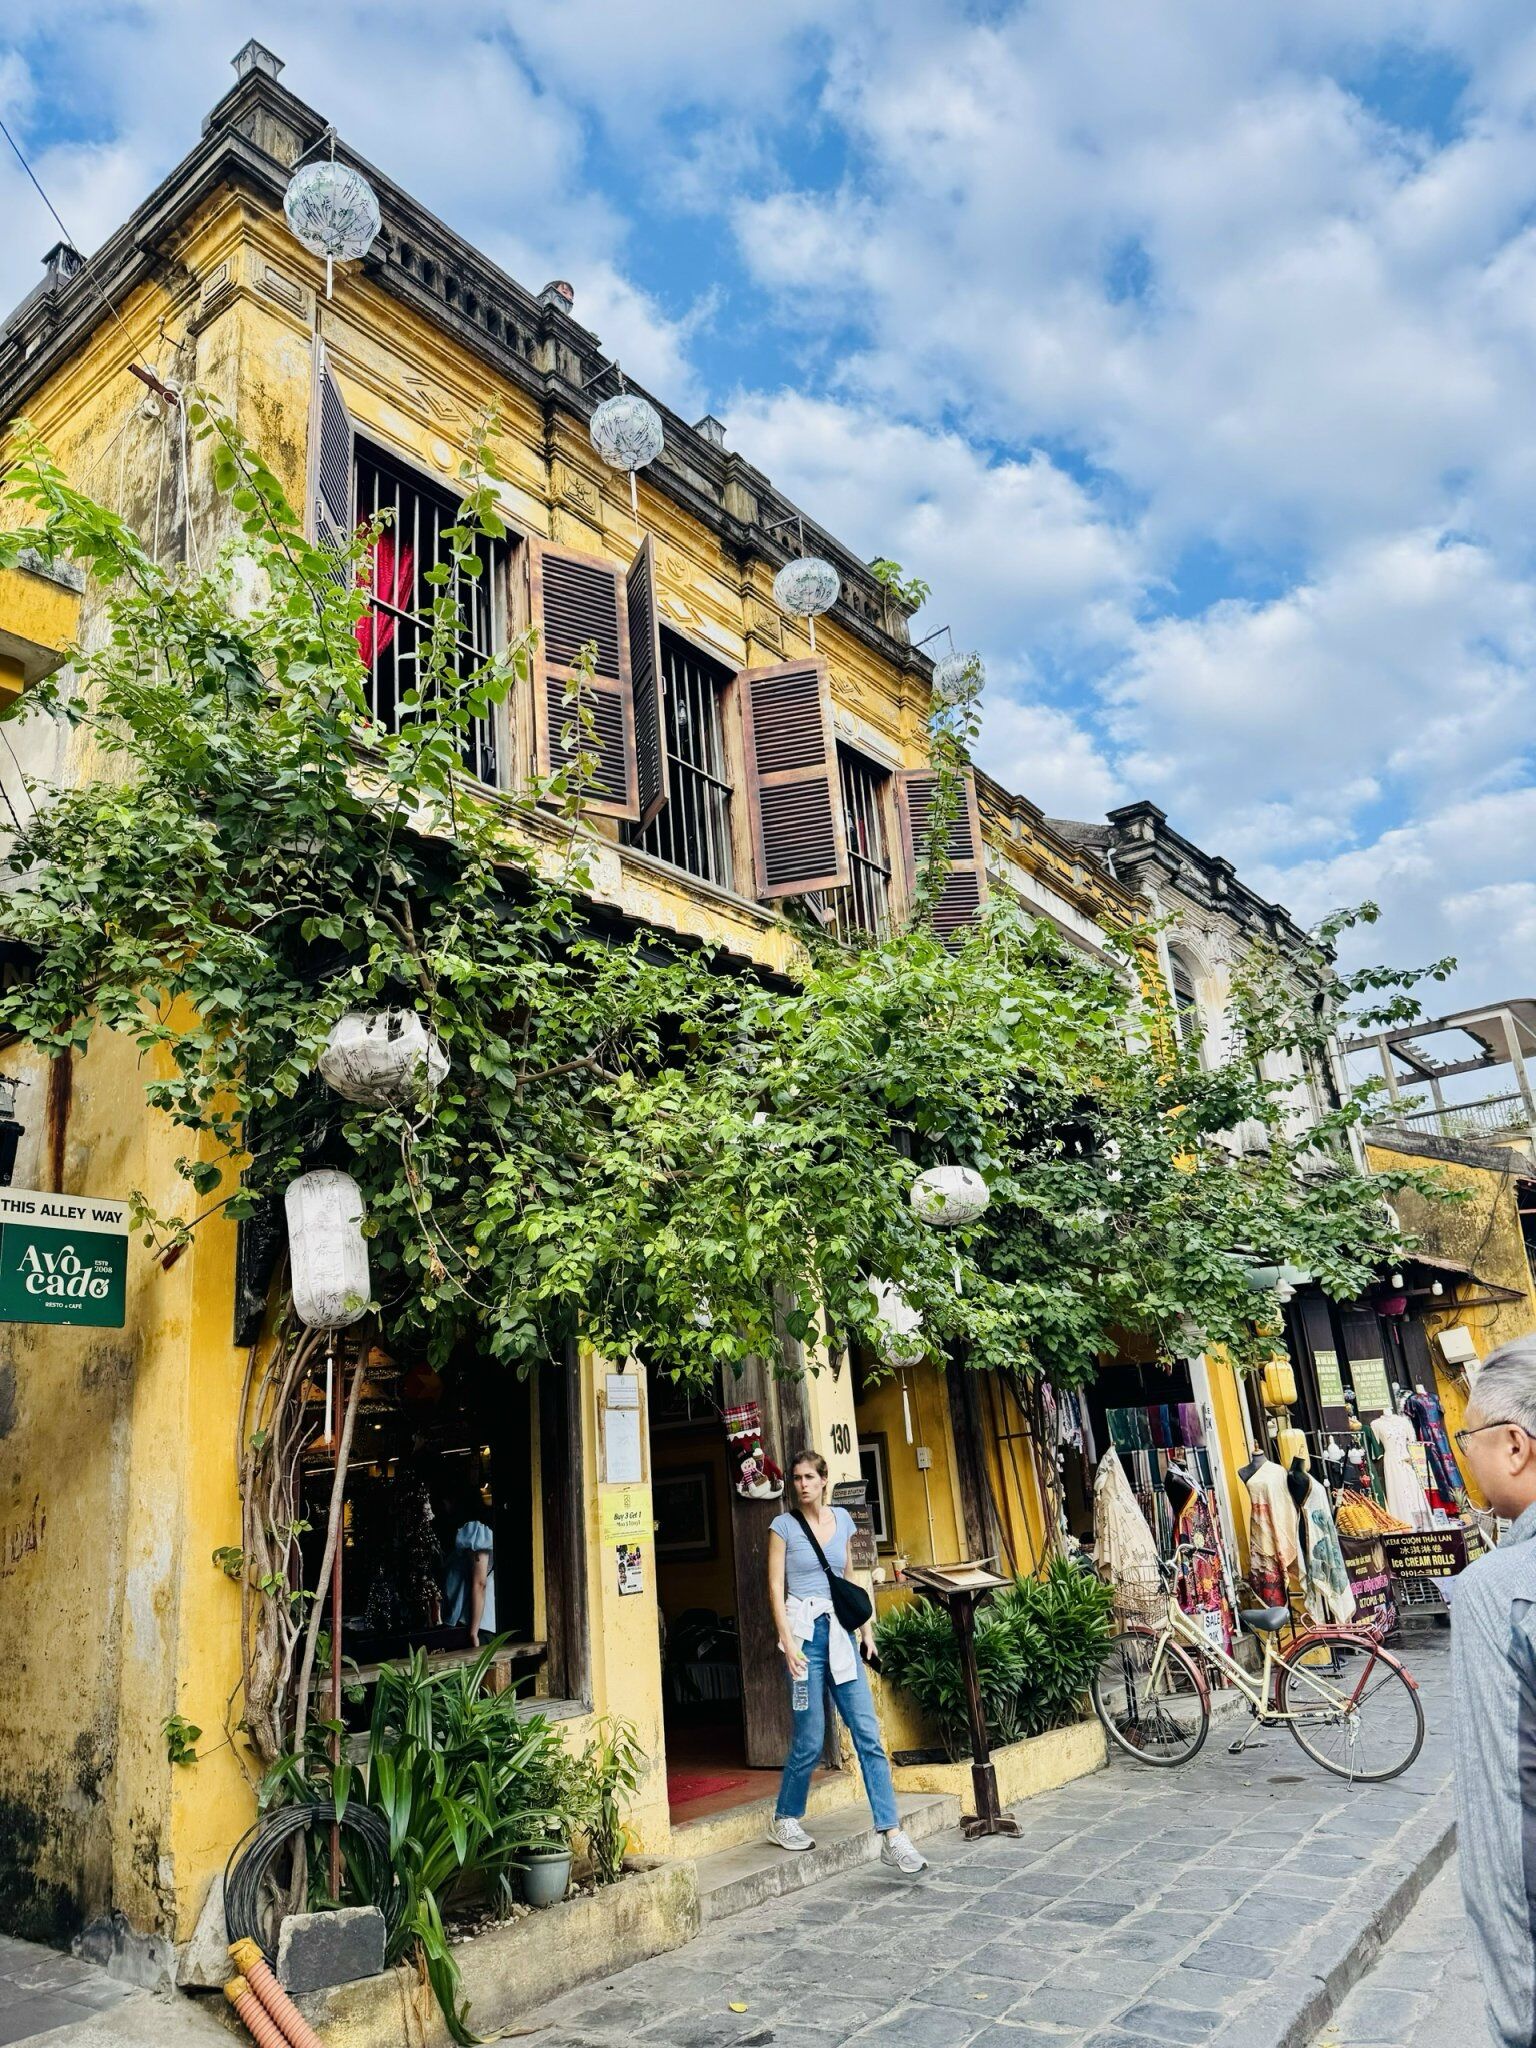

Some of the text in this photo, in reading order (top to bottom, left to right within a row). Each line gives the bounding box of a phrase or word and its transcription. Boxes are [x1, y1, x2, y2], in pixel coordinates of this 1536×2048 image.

[1, 1199, 123, 1223] THIS ALLEY WAY
[16, 1244, 82, 1276] Avo
[94, 1266, 113, 1274] 2008
[25, 1267, 110, 1299] cado
[68, 1302, 82, 1310] CAFÉ
[830, 1423, 851, 1455] 130
[613, 1512, 624, 1521] Buy
[624, 1512, 629, 1520] 3
[629, 1511, 638, 1519] Get
[1386, 1538, 1400, 1546] KEM
[1437, 1534, 1452, 1542] LAN
[1391, 1554, 1456, 1568] Ice CREAM ROLLS
